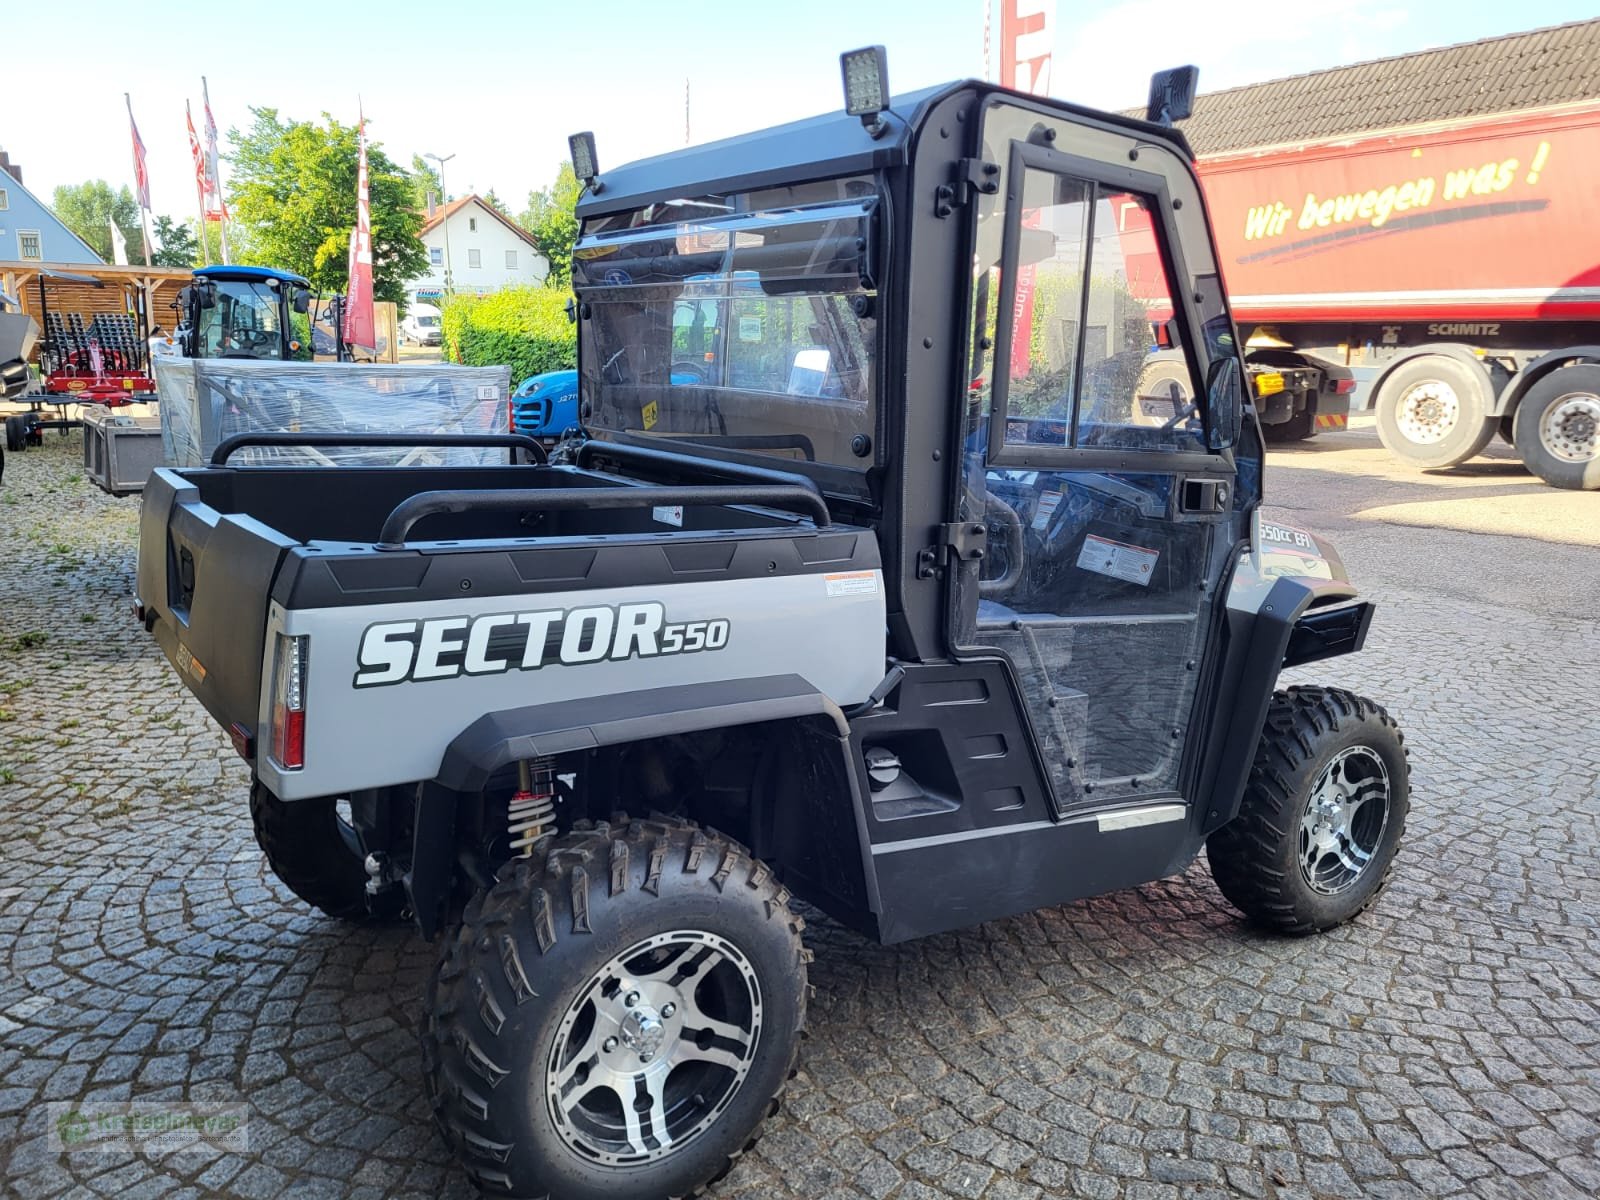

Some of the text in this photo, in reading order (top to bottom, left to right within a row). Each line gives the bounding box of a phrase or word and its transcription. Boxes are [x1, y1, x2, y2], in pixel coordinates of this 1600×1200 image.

[1244, 202, 1293, 240] Wir
[1297, 176, 1436, 228] bewegen
[1442, 158, 1520, 201] was
[1427, 323, 1501, 336] SCHMITZ
[1294, 531, 1310, 548] EFI
[354, 601, 731, 688] SECTOR 550
